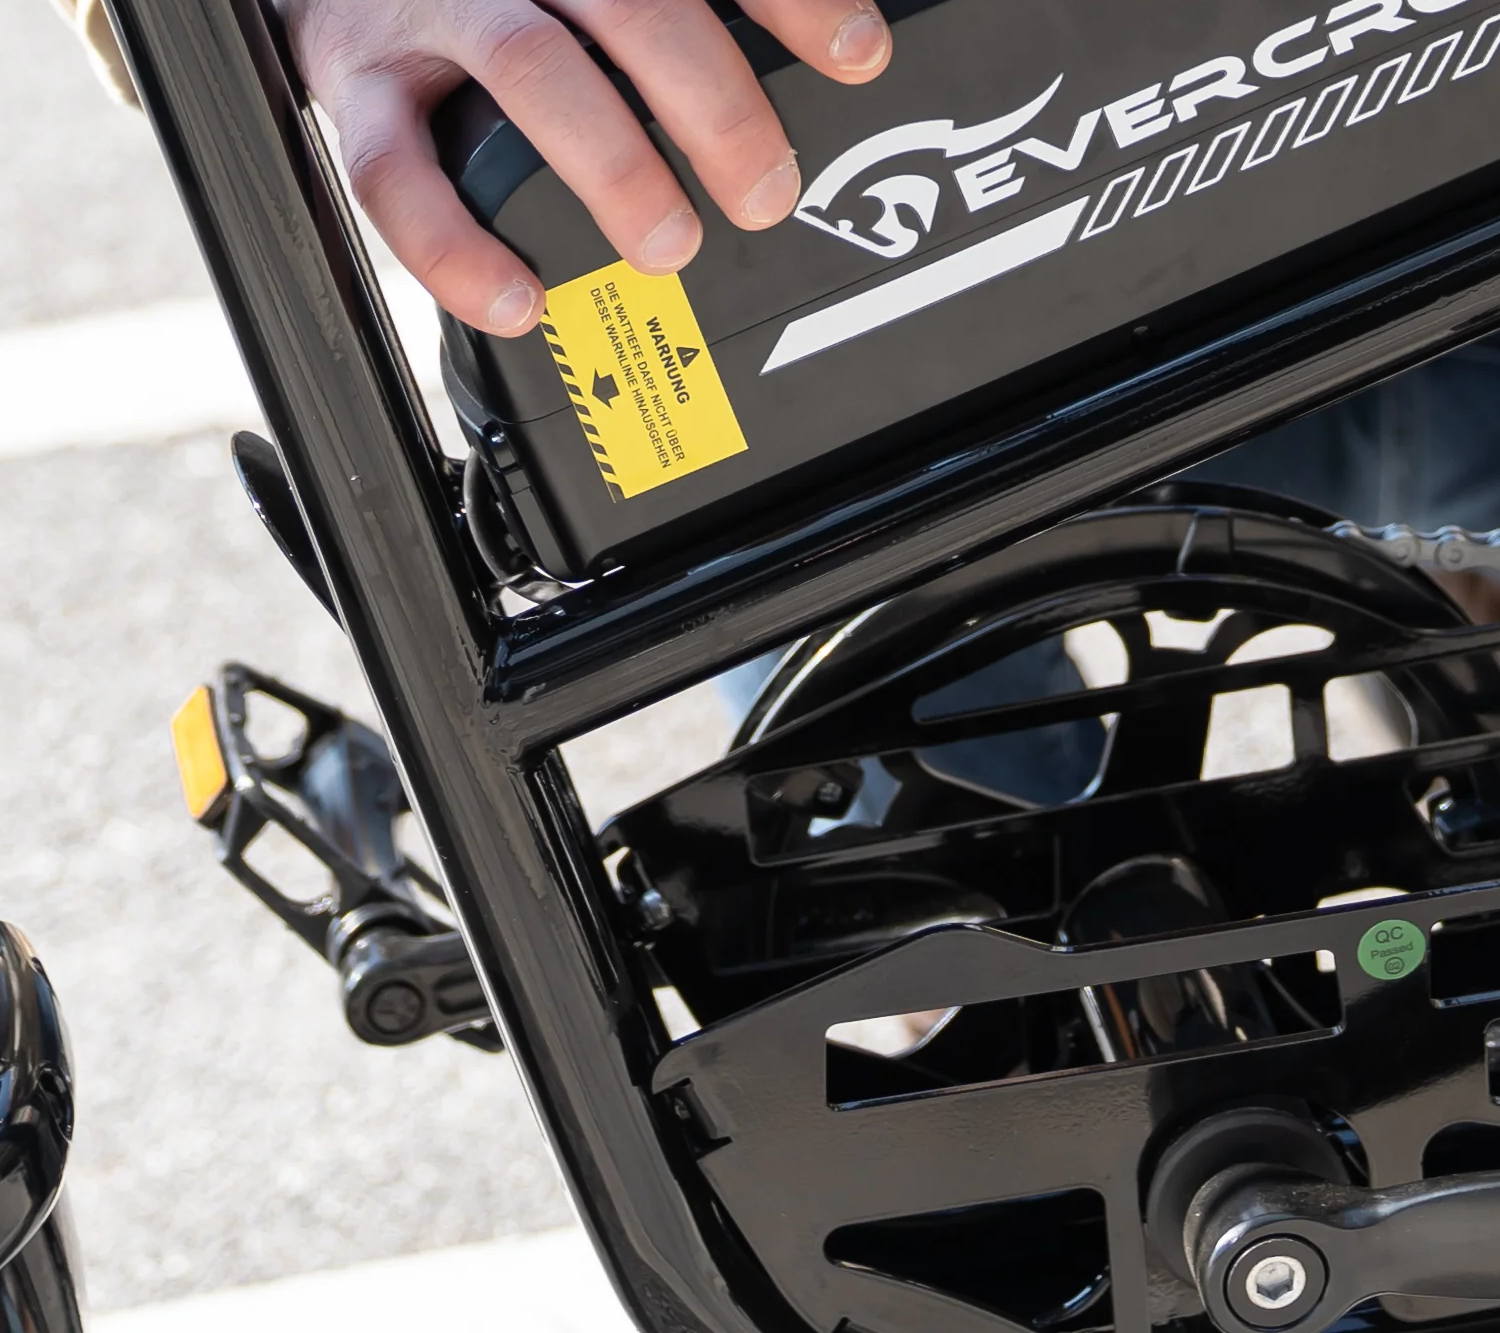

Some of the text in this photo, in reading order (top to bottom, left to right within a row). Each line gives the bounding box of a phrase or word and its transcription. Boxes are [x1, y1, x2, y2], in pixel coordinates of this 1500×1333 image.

[590, 287, 672, 469] DIESE WARNLINIE HINAUSGEHEN
[604, 281, 686, 462] DIE WATTIEFE DARF NICHT ÜBER
[645, 316, 691, 405] WARNUNG
[1370, 940, 1414, 960] Passed
[1375, 925, 1404, 944] QC
